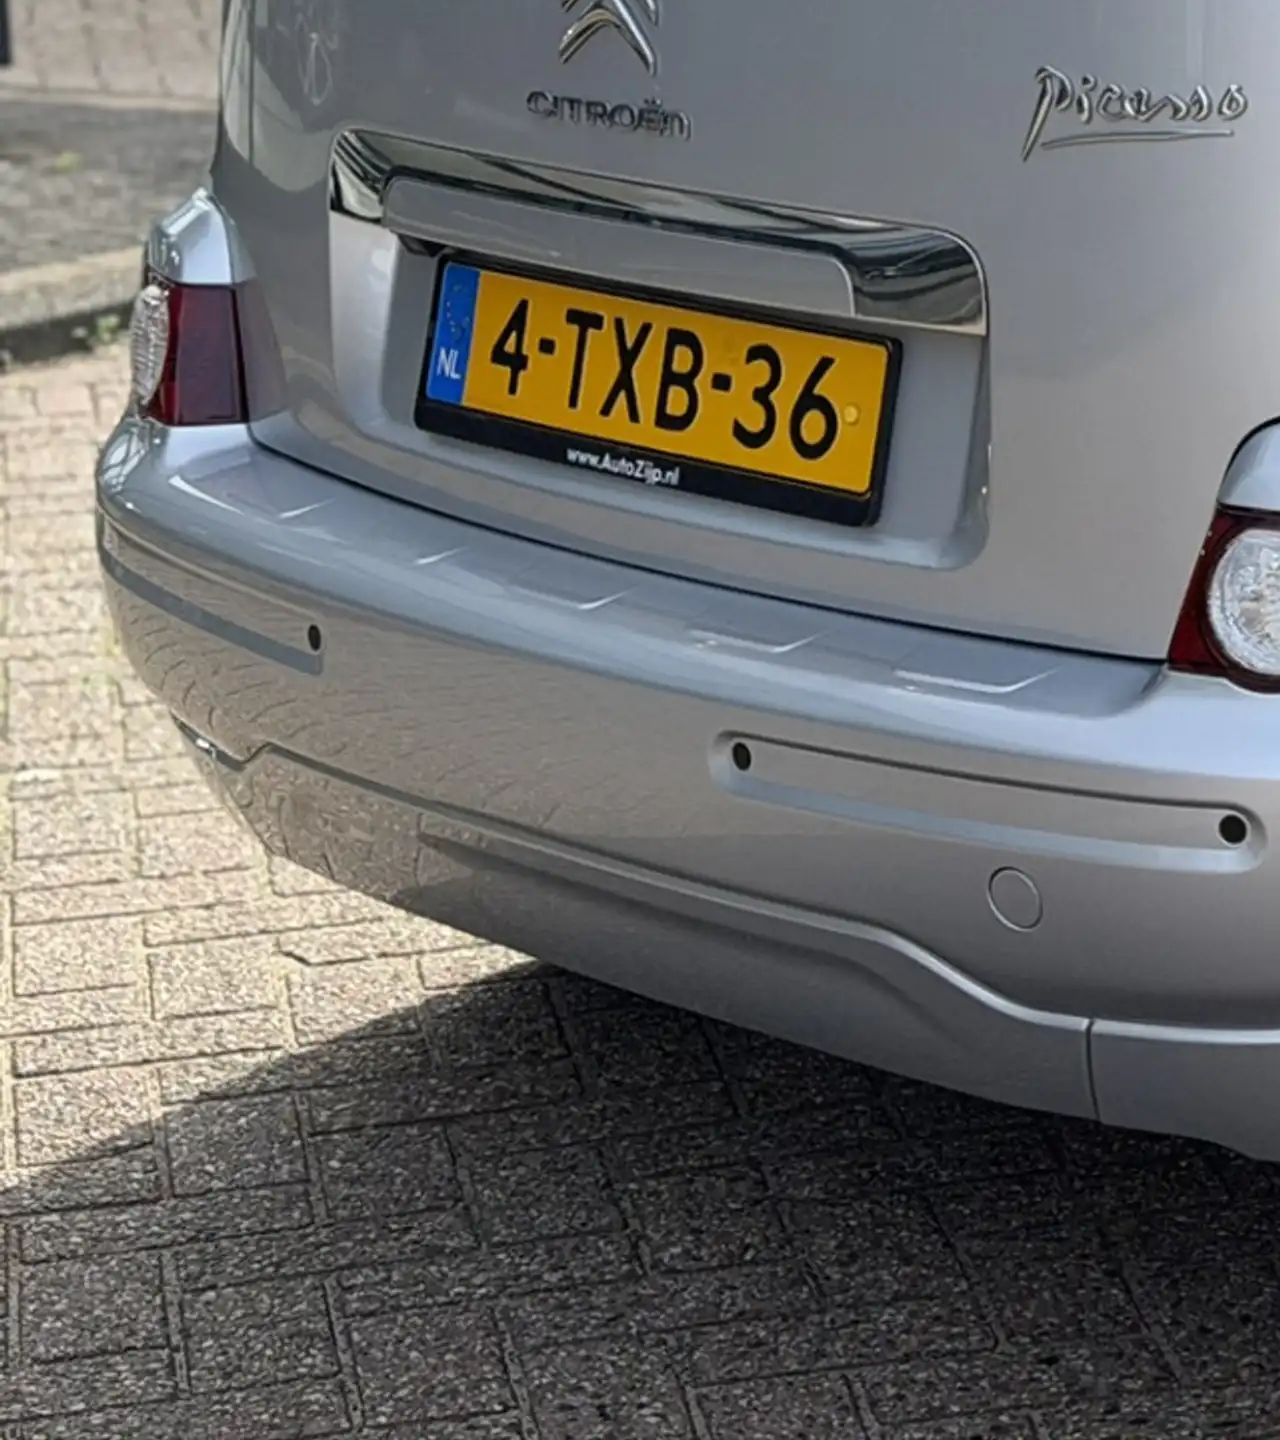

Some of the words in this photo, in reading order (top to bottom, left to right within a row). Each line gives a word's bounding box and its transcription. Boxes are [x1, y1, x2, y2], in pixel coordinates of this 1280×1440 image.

[1021, 65, 1248, 162] Picasso
[436, 347, 461, 379] NL
[490, 298, 839, 460] 4-TXB-36
